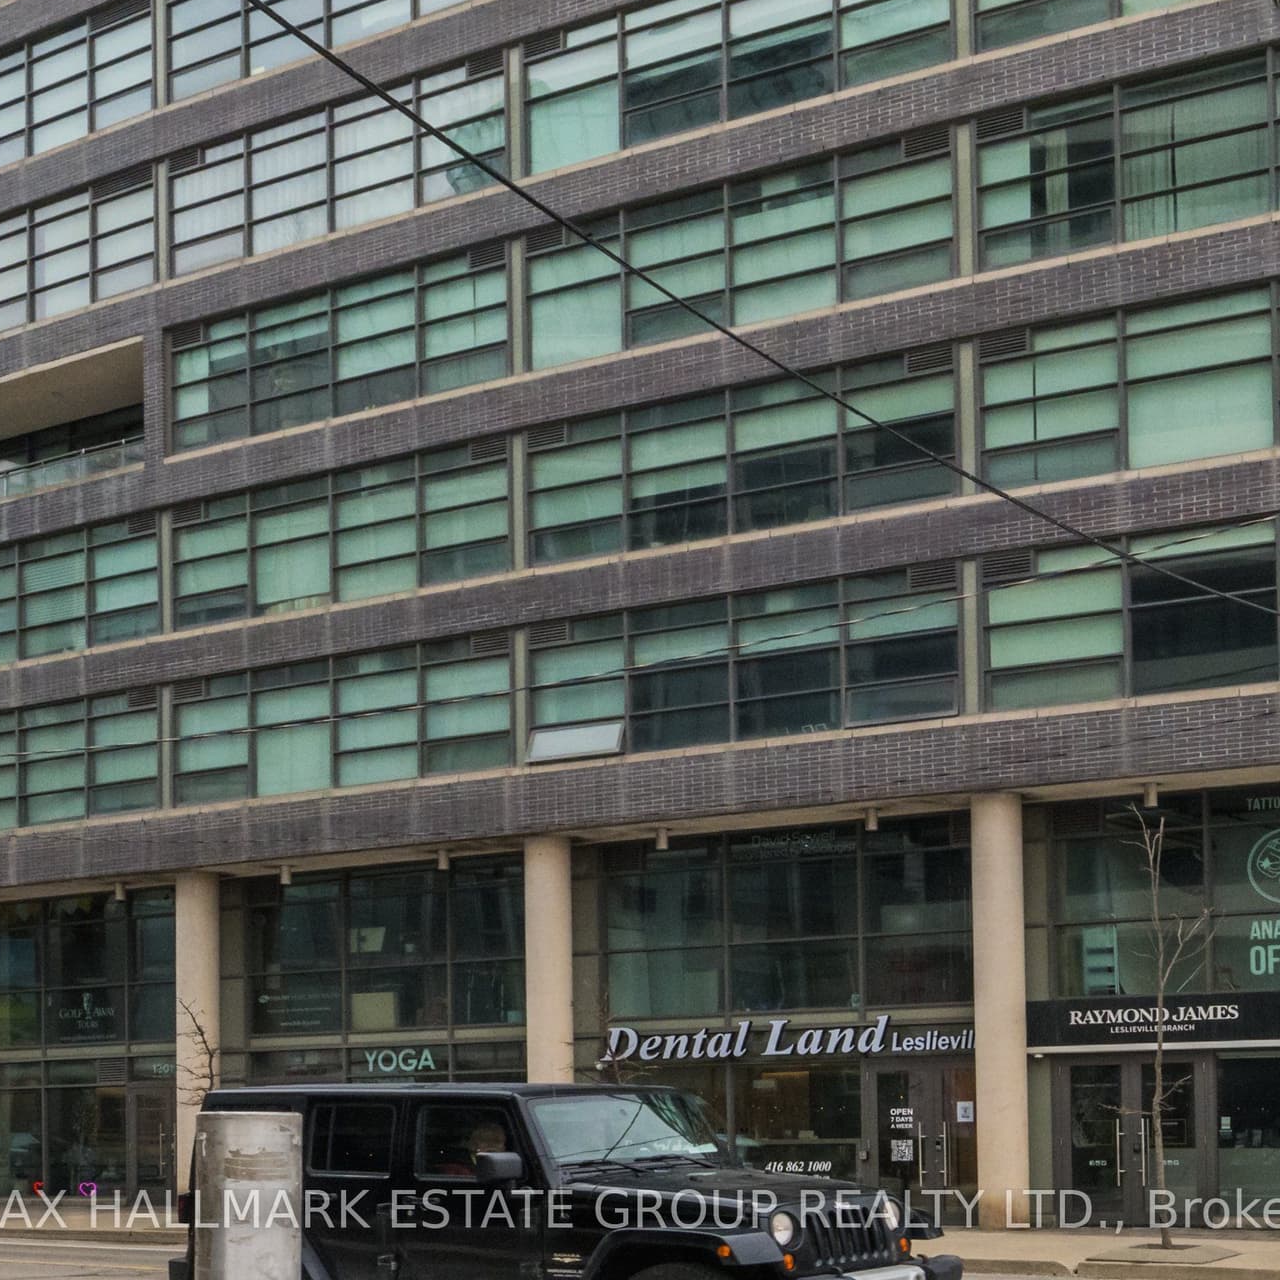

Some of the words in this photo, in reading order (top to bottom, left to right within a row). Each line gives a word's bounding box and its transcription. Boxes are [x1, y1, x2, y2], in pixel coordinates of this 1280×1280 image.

[1069, 1007, 1170, 1025] RAYMOND
[1172, 1004, 1239, 1022] JAMES
[600, 1021, 751, 1062] Dental
[760, 1015, 891, 1057] Land
[364, 1048, 436, 1072] YOGA
[890, 1108, 913, 1116] OPEN
[765, 1161, 784, 1172] 416
[785, 1161, 805, 1172] 862
[807, 1161, 832, 1172] 1000
